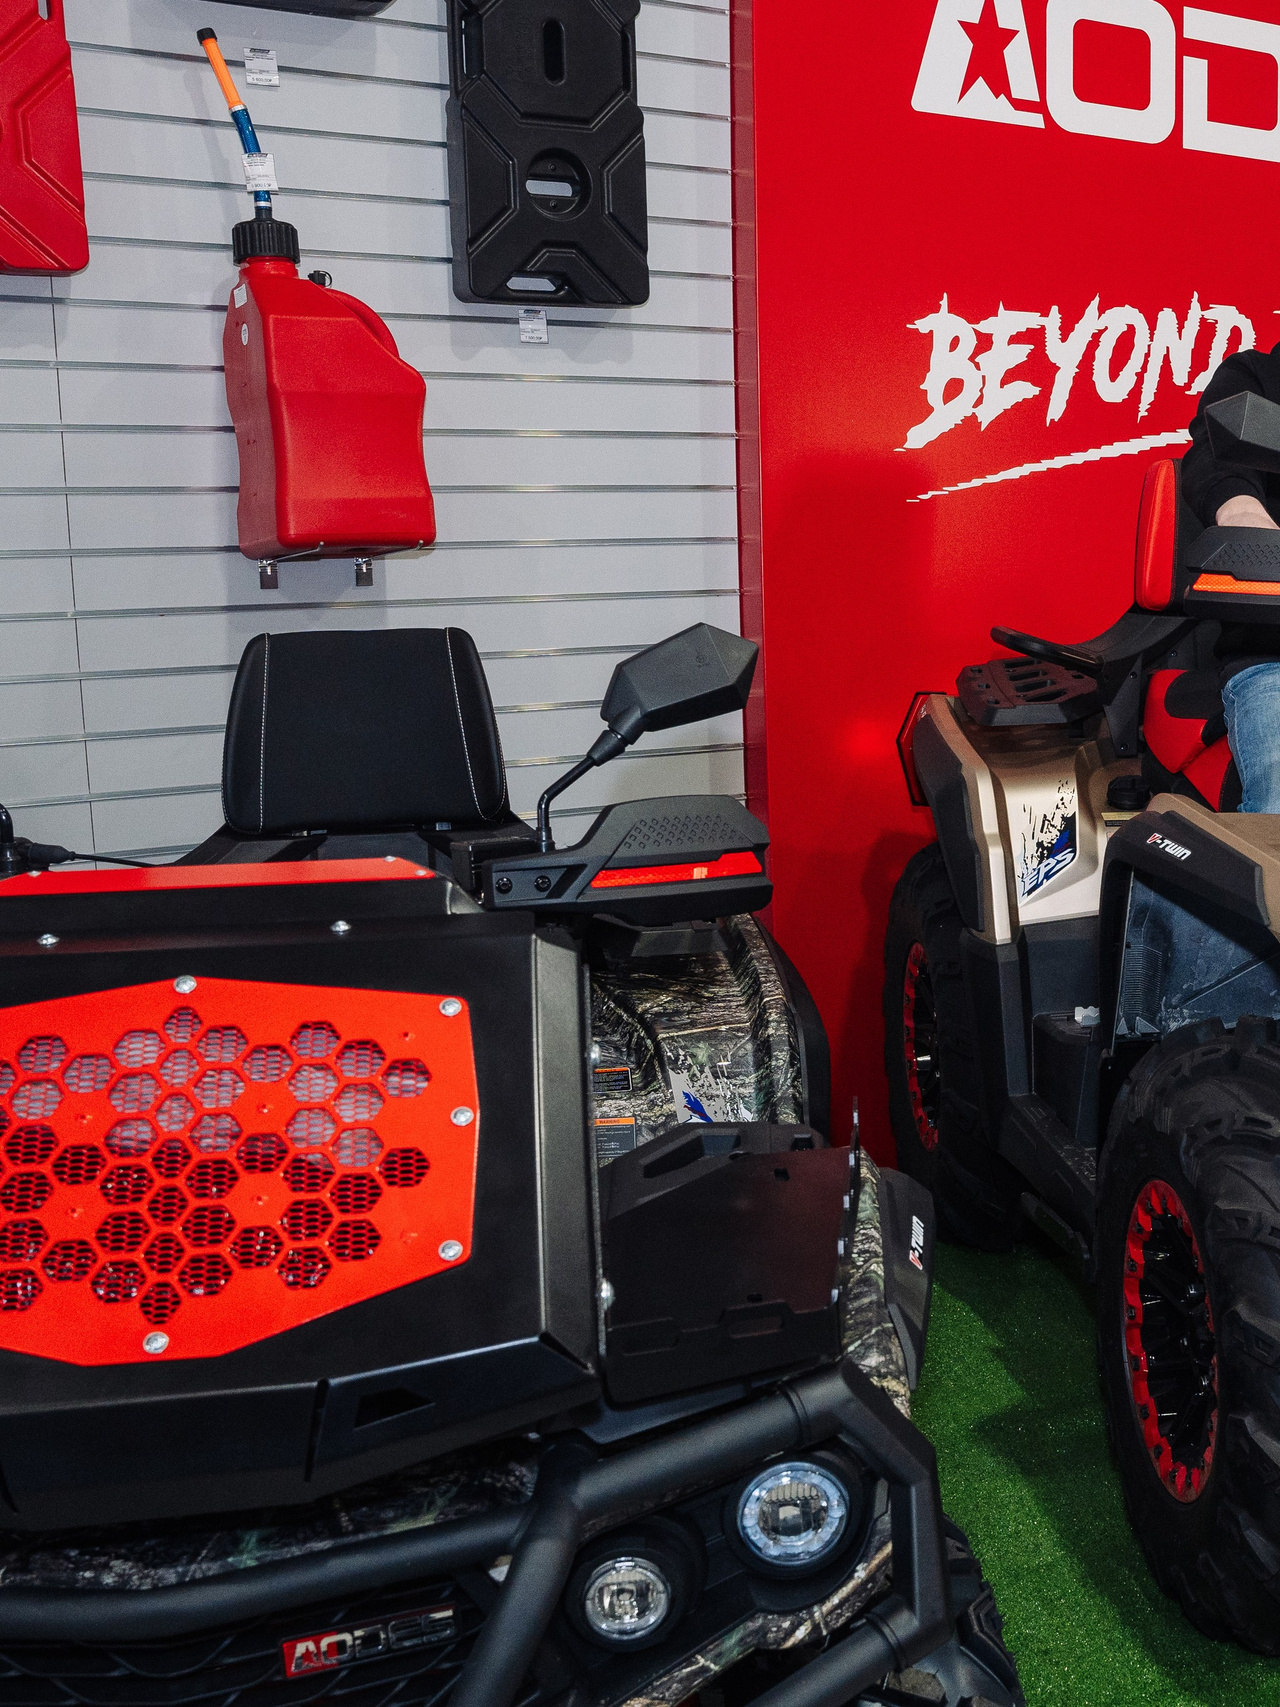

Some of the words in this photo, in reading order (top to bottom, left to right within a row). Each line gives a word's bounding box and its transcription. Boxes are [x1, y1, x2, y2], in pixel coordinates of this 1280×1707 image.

[896, 291, 1256, 450] BEYOND
[1023, 848, 1075, 893] EPS
[1147, 832, 1192, 862] V-TWIN
[909, 1215, 924, 1270] V-TWIN
[291, 1609, 455, 1673] AODES
